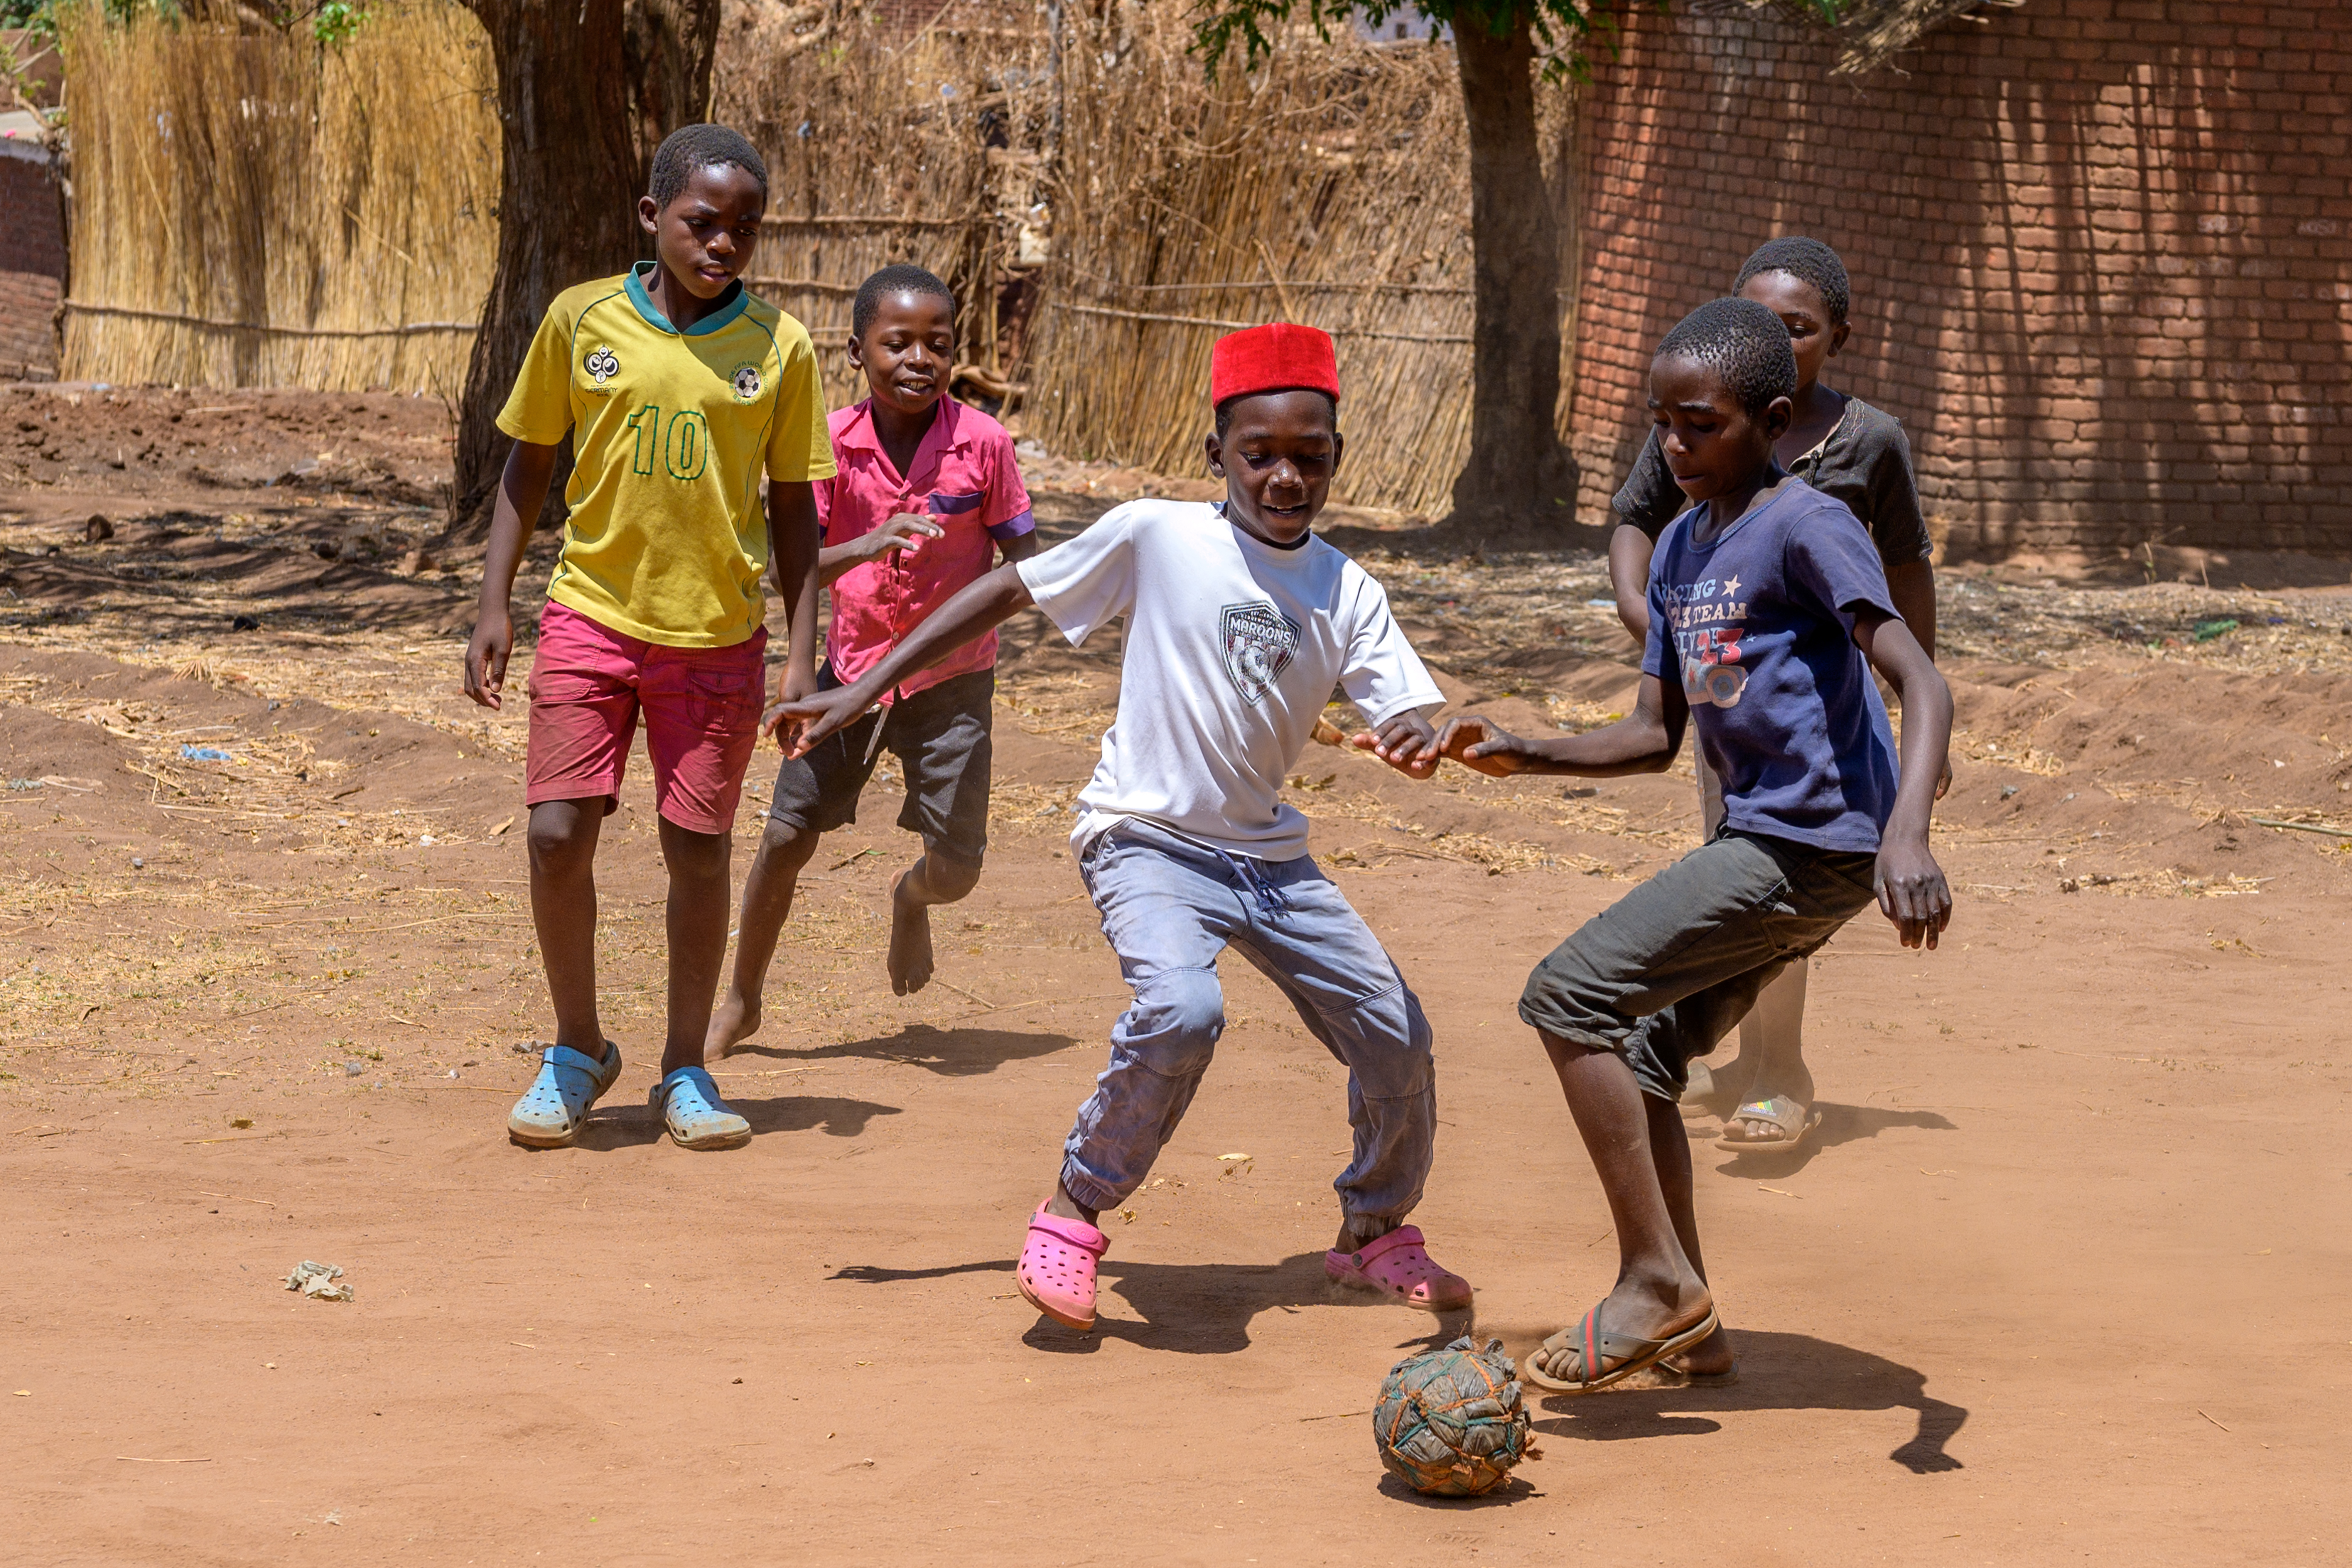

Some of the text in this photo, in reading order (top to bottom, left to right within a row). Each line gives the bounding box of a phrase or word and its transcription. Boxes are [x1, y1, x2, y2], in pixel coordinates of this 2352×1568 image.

[735, 361, 747, 370] FIFA
[748, 361, 767, 377] WORLD
[733, 393, 757, 406] BRASIL
[627, 405, 707, 480] 10
[1693, 602, 1747, 624] TEAM
[1230, 616, 1291, 644] MAROONS
[1697, 628, 1744, 665] 23
